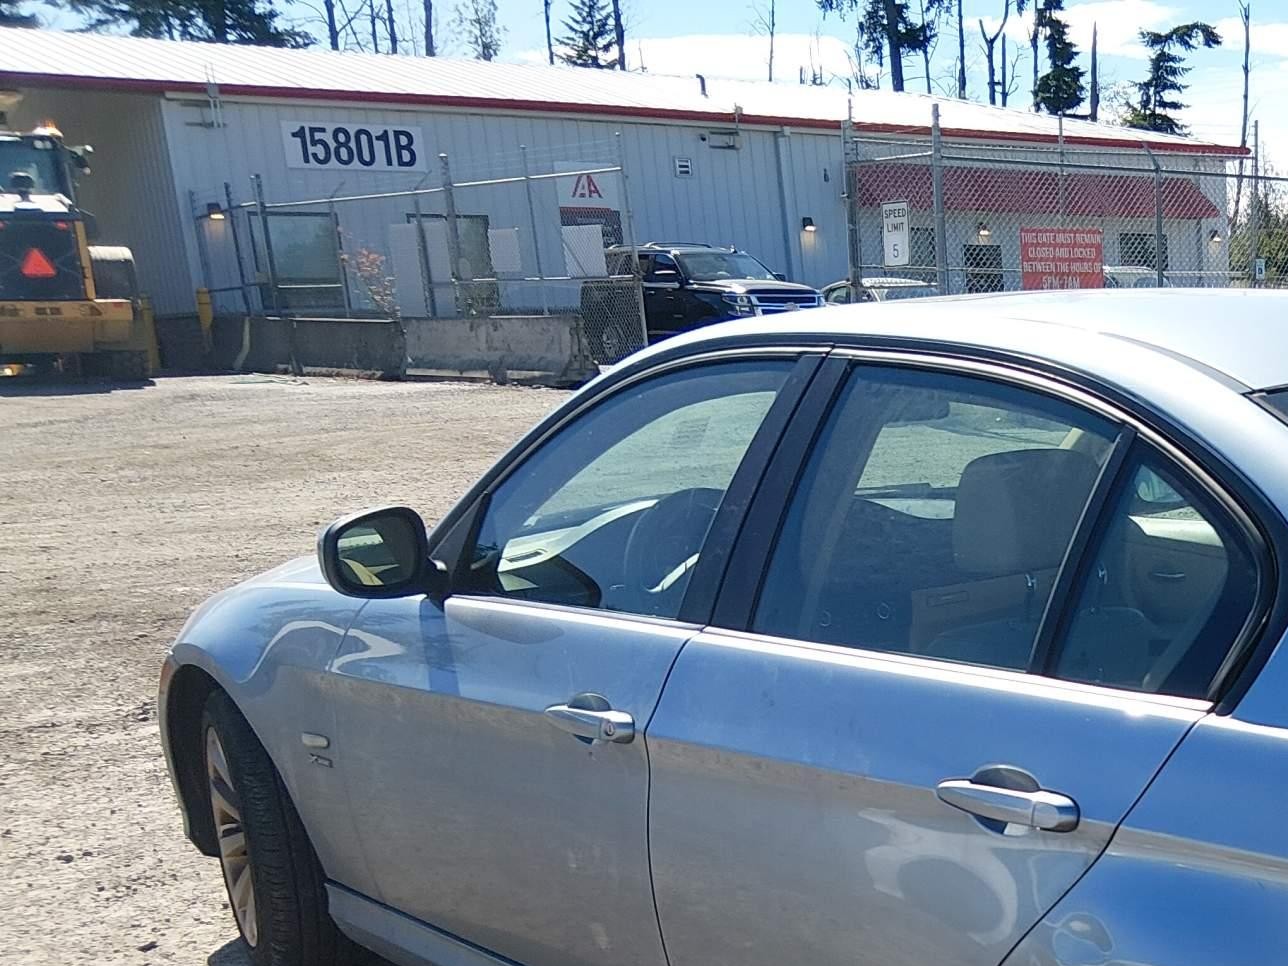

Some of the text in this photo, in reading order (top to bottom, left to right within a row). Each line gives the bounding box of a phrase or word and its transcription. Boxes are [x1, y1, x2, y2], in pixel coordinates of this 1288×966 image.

[290, 125, 417, 168] 15801B
[884, 207, 907, 219] SPEED
[886, 222, 905, 233] LIMIT
[1021, 232, 1103, 245] THIS GATE MUST REMAIN
[892, 243, 900, 259] 5
[1028, 247, 1096, 259] CLOSED AND LOCKED
[1023, 261, 1103, 273] BETWEEN THE HOURS OF
